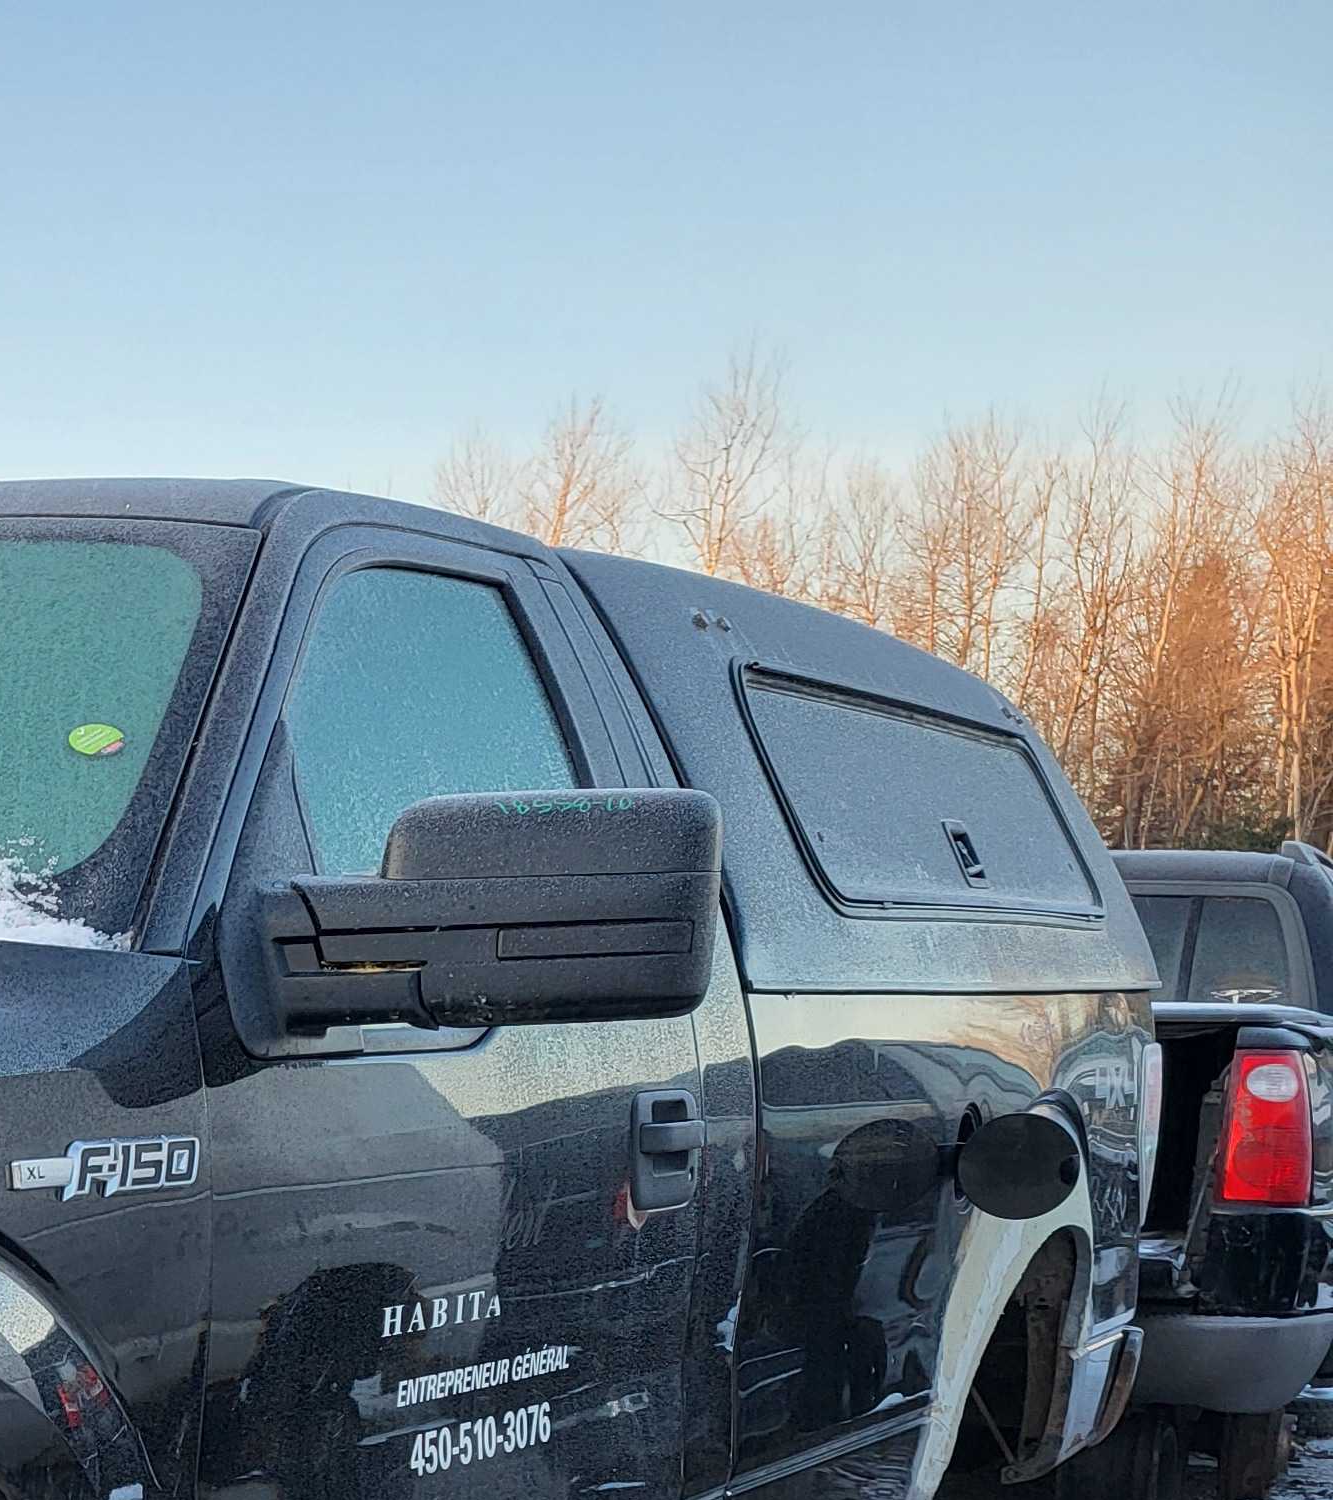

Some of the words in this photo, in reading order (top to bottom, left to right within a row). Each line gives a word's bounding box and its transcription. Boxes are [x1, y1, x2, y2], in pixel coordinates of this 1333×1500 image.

[26, 1166, 46, 1181] XL
[69, 1137, 199, 1198] F-150
[380, 1290, 502, 1338] HABITA
[396, 1358, 510, 1408] ENTREPRENEUR
[511, 1343, 571, 1381] GÉNÉRAL
[409, 1401, 552, 1477] 450-510-3076
